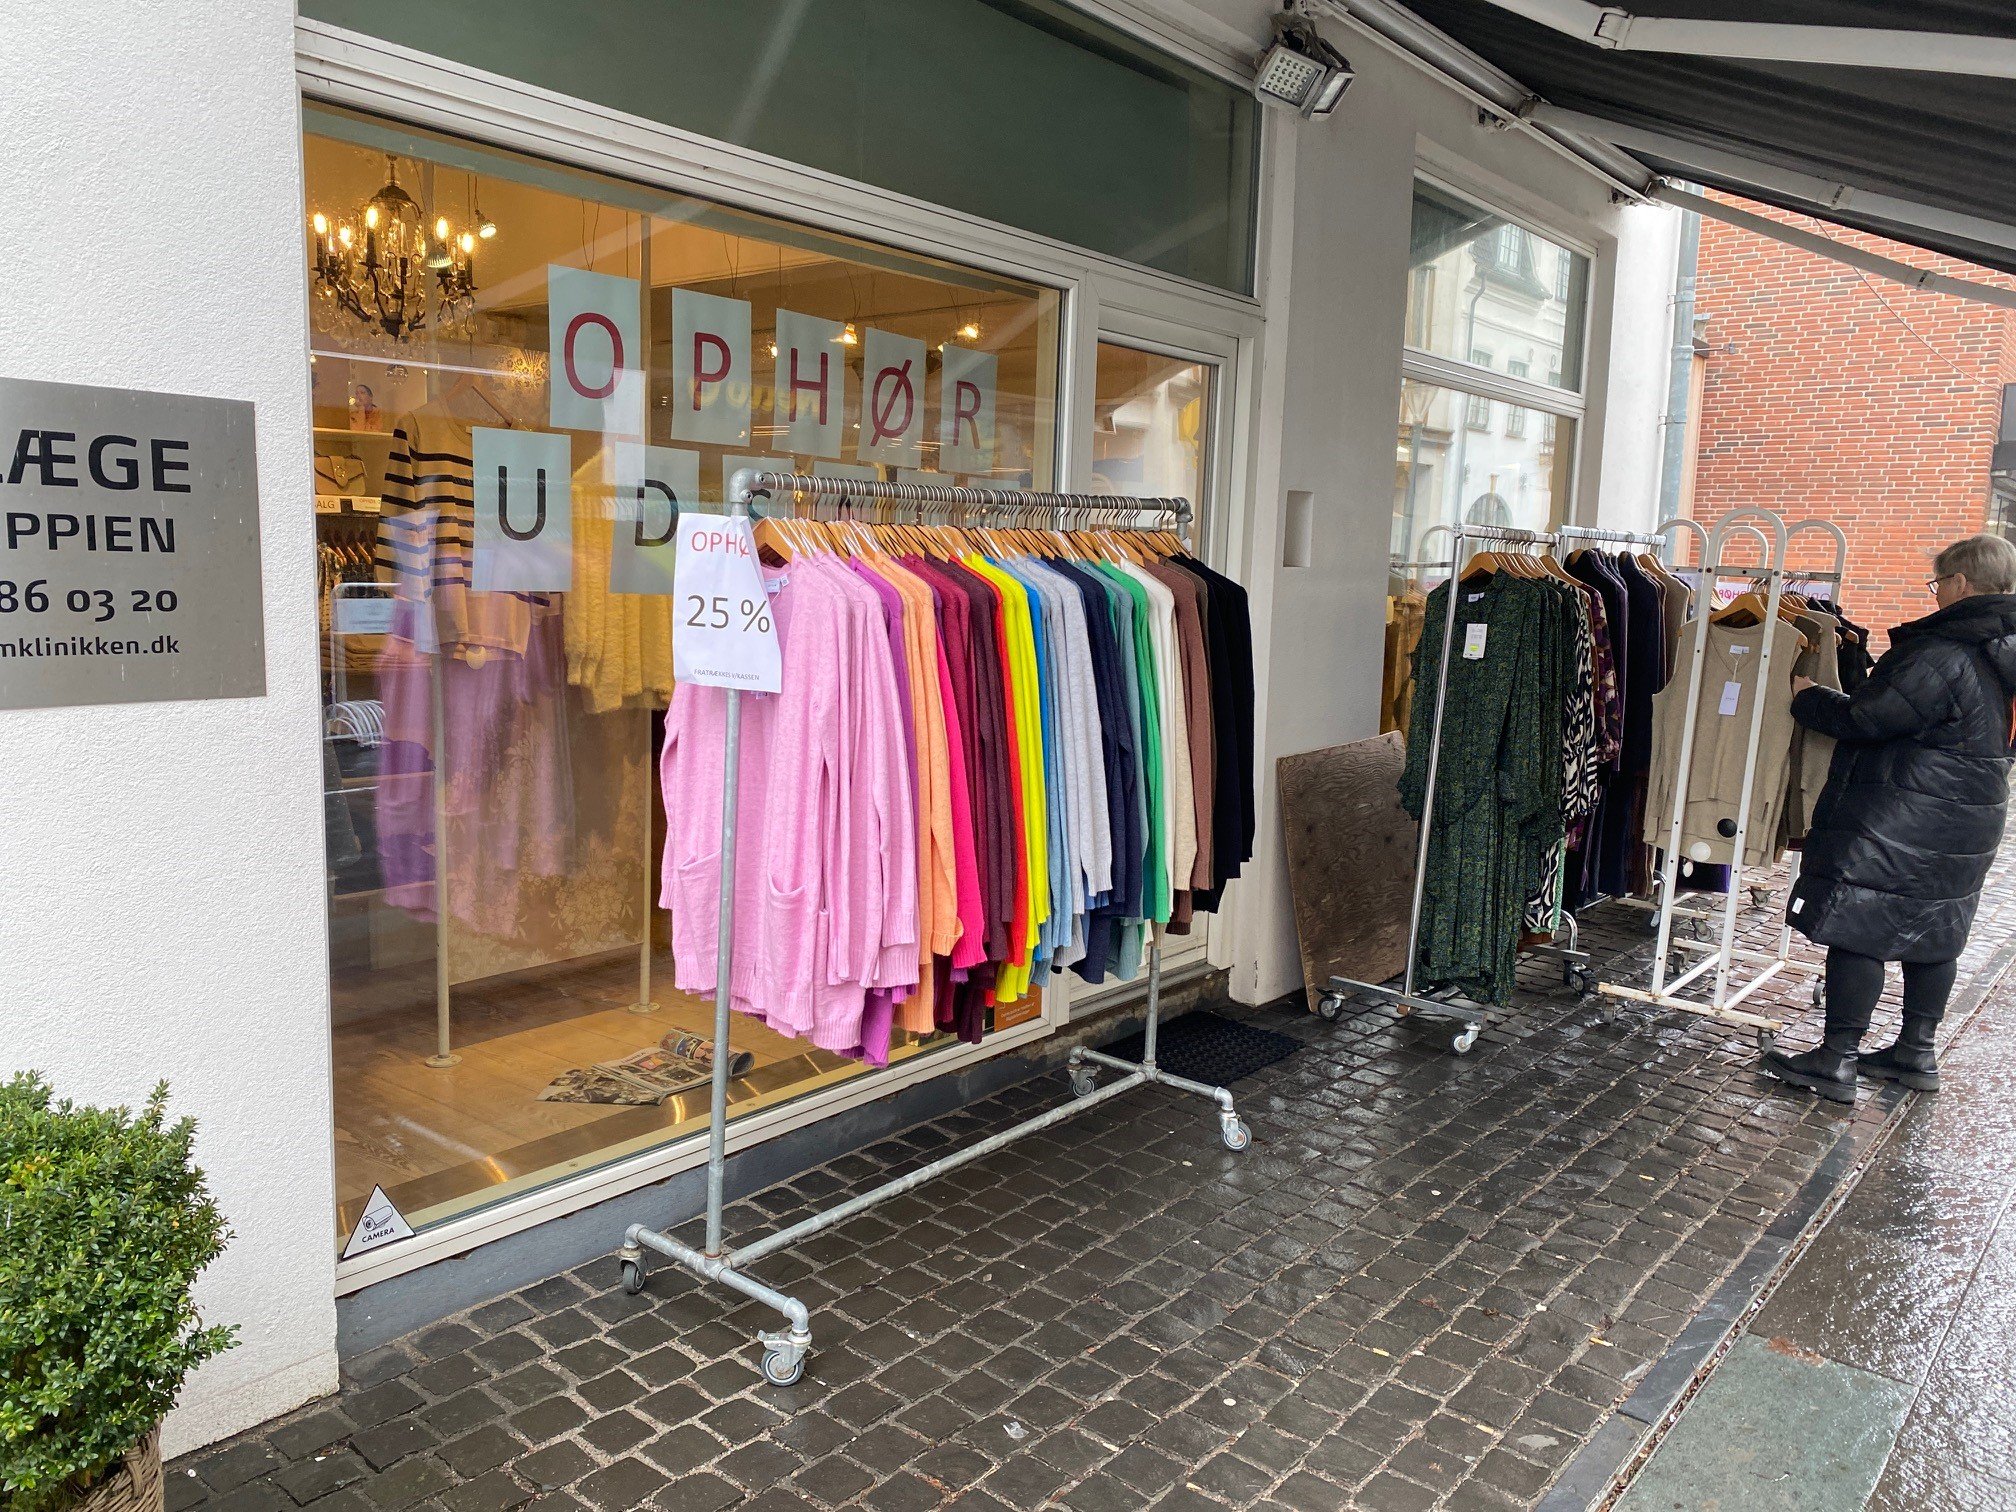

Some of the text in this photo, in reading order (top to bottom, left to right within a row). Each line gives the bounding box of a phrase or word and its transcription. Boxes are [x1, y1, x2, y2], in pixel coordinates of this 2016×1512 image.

[0, 429, 192, 493] ÆGE
[6, 512, 176, 552] PPIEN
[0, 579, 178, 622] 86 03 20
[687, 594, 770, 633] 25 %
[0, 635, 180, 657] mklinikken.dk
[361, 1227, 395, 1243] CAMERA
